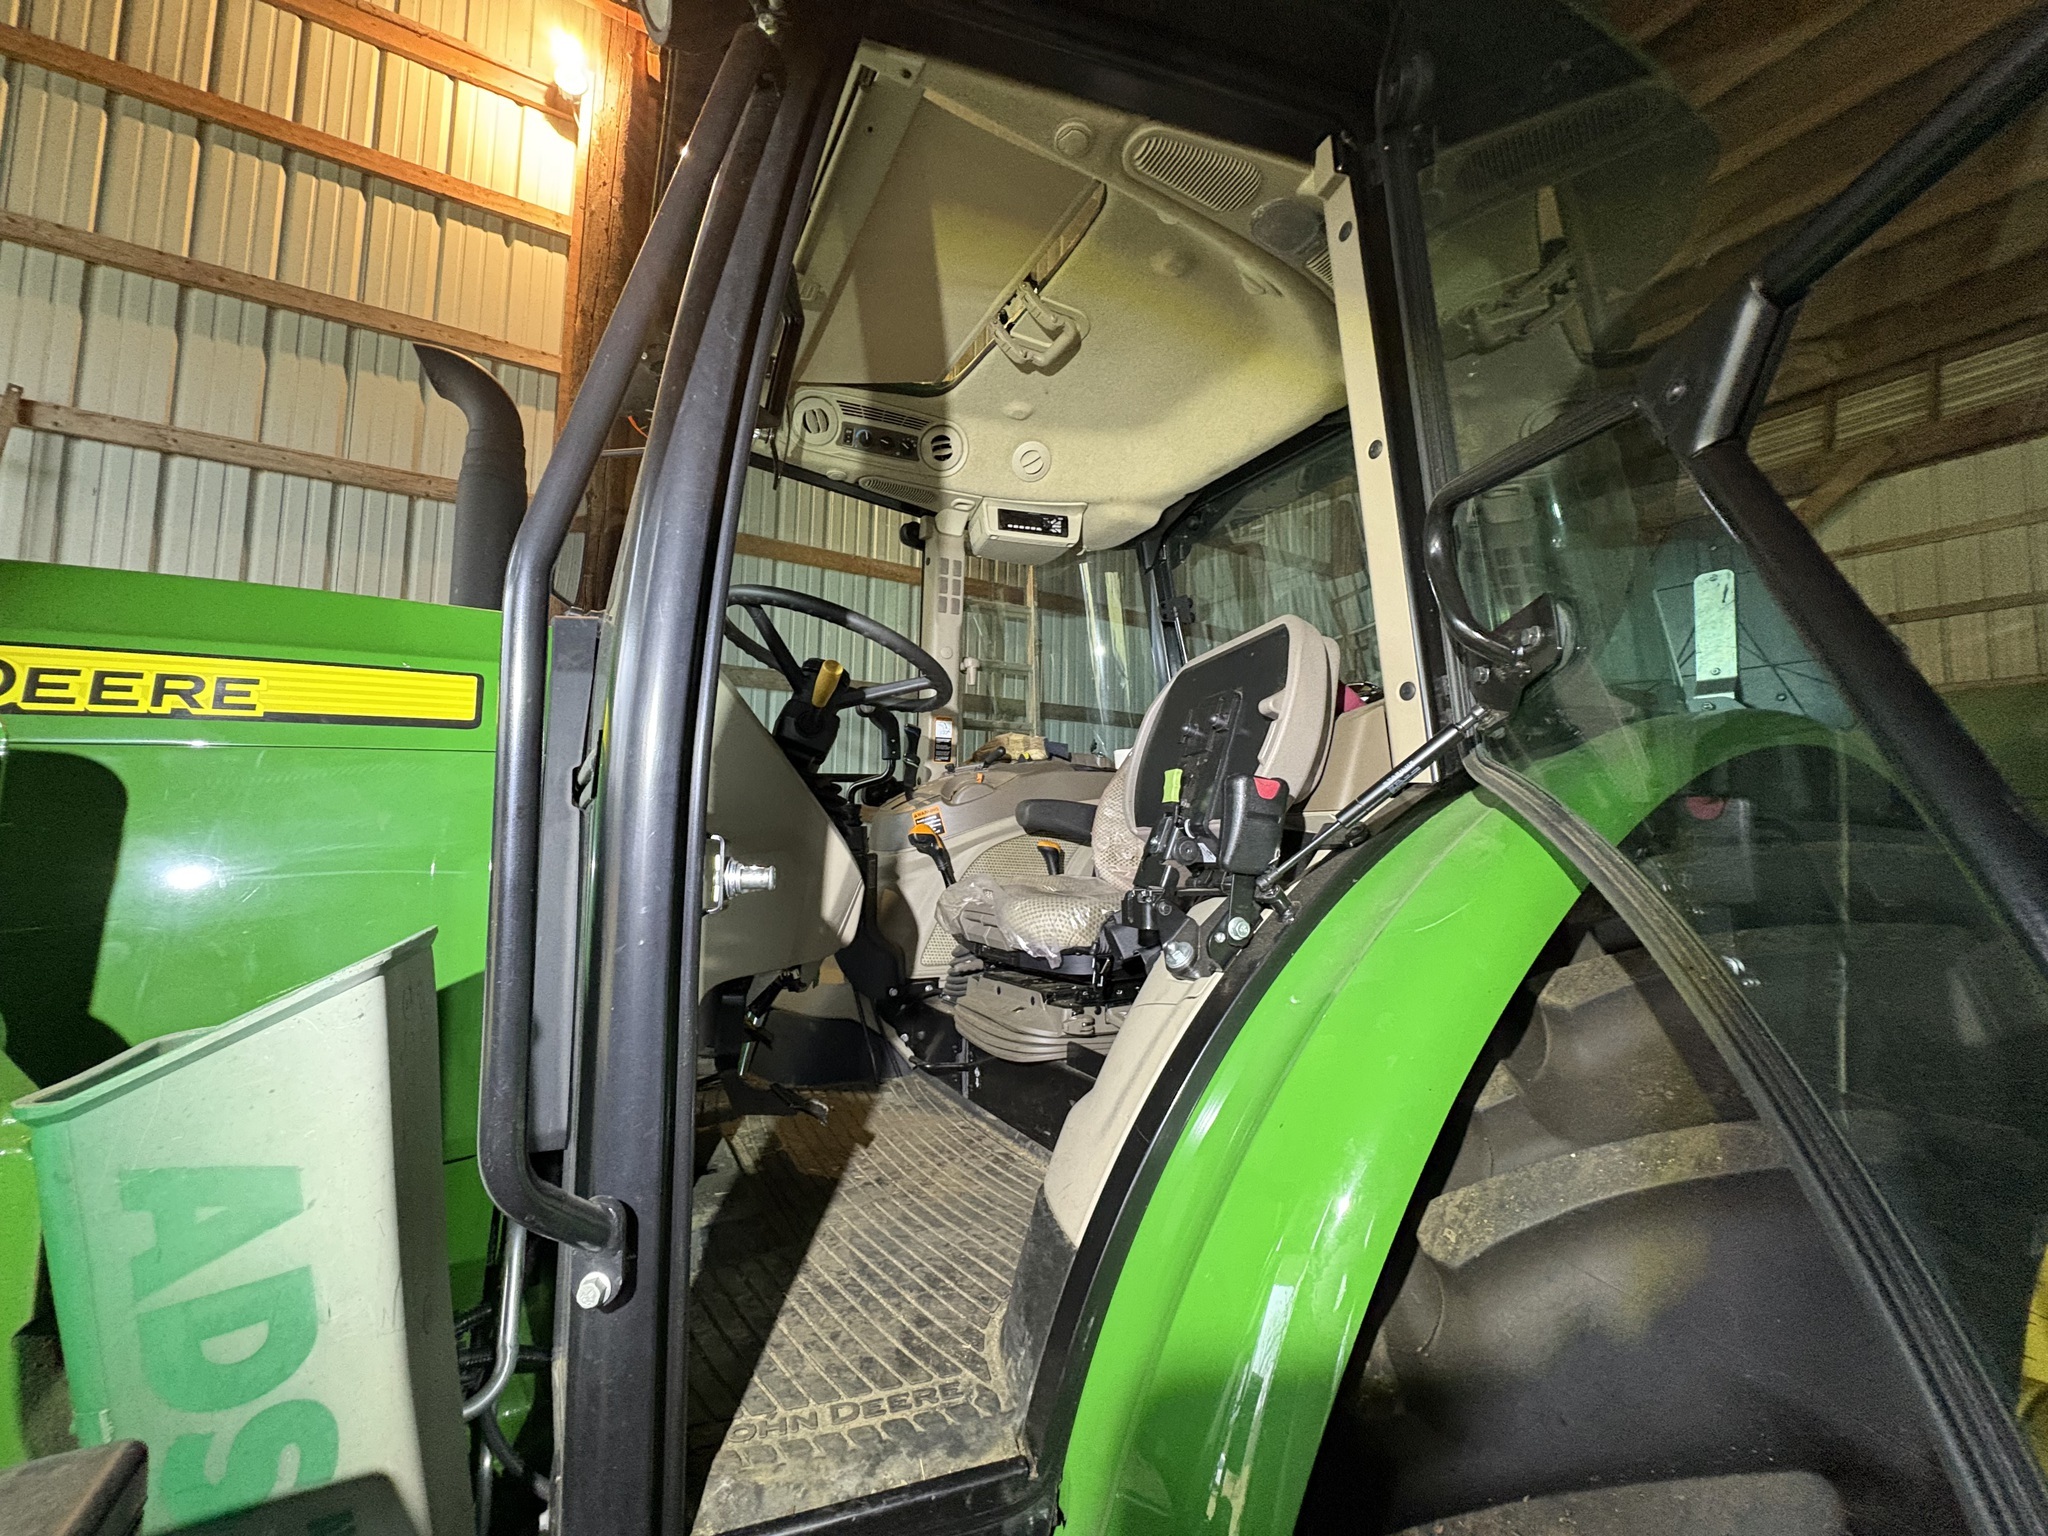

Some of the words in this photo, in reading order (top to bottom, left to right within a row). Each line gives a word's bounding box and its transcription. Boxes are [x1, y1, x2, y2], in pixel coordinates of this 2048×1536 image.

[0, 659, 261, 711] EERE
[727, 1410, 819, 1443] OHN
[829, 1381, 965, 1426] DEERE
